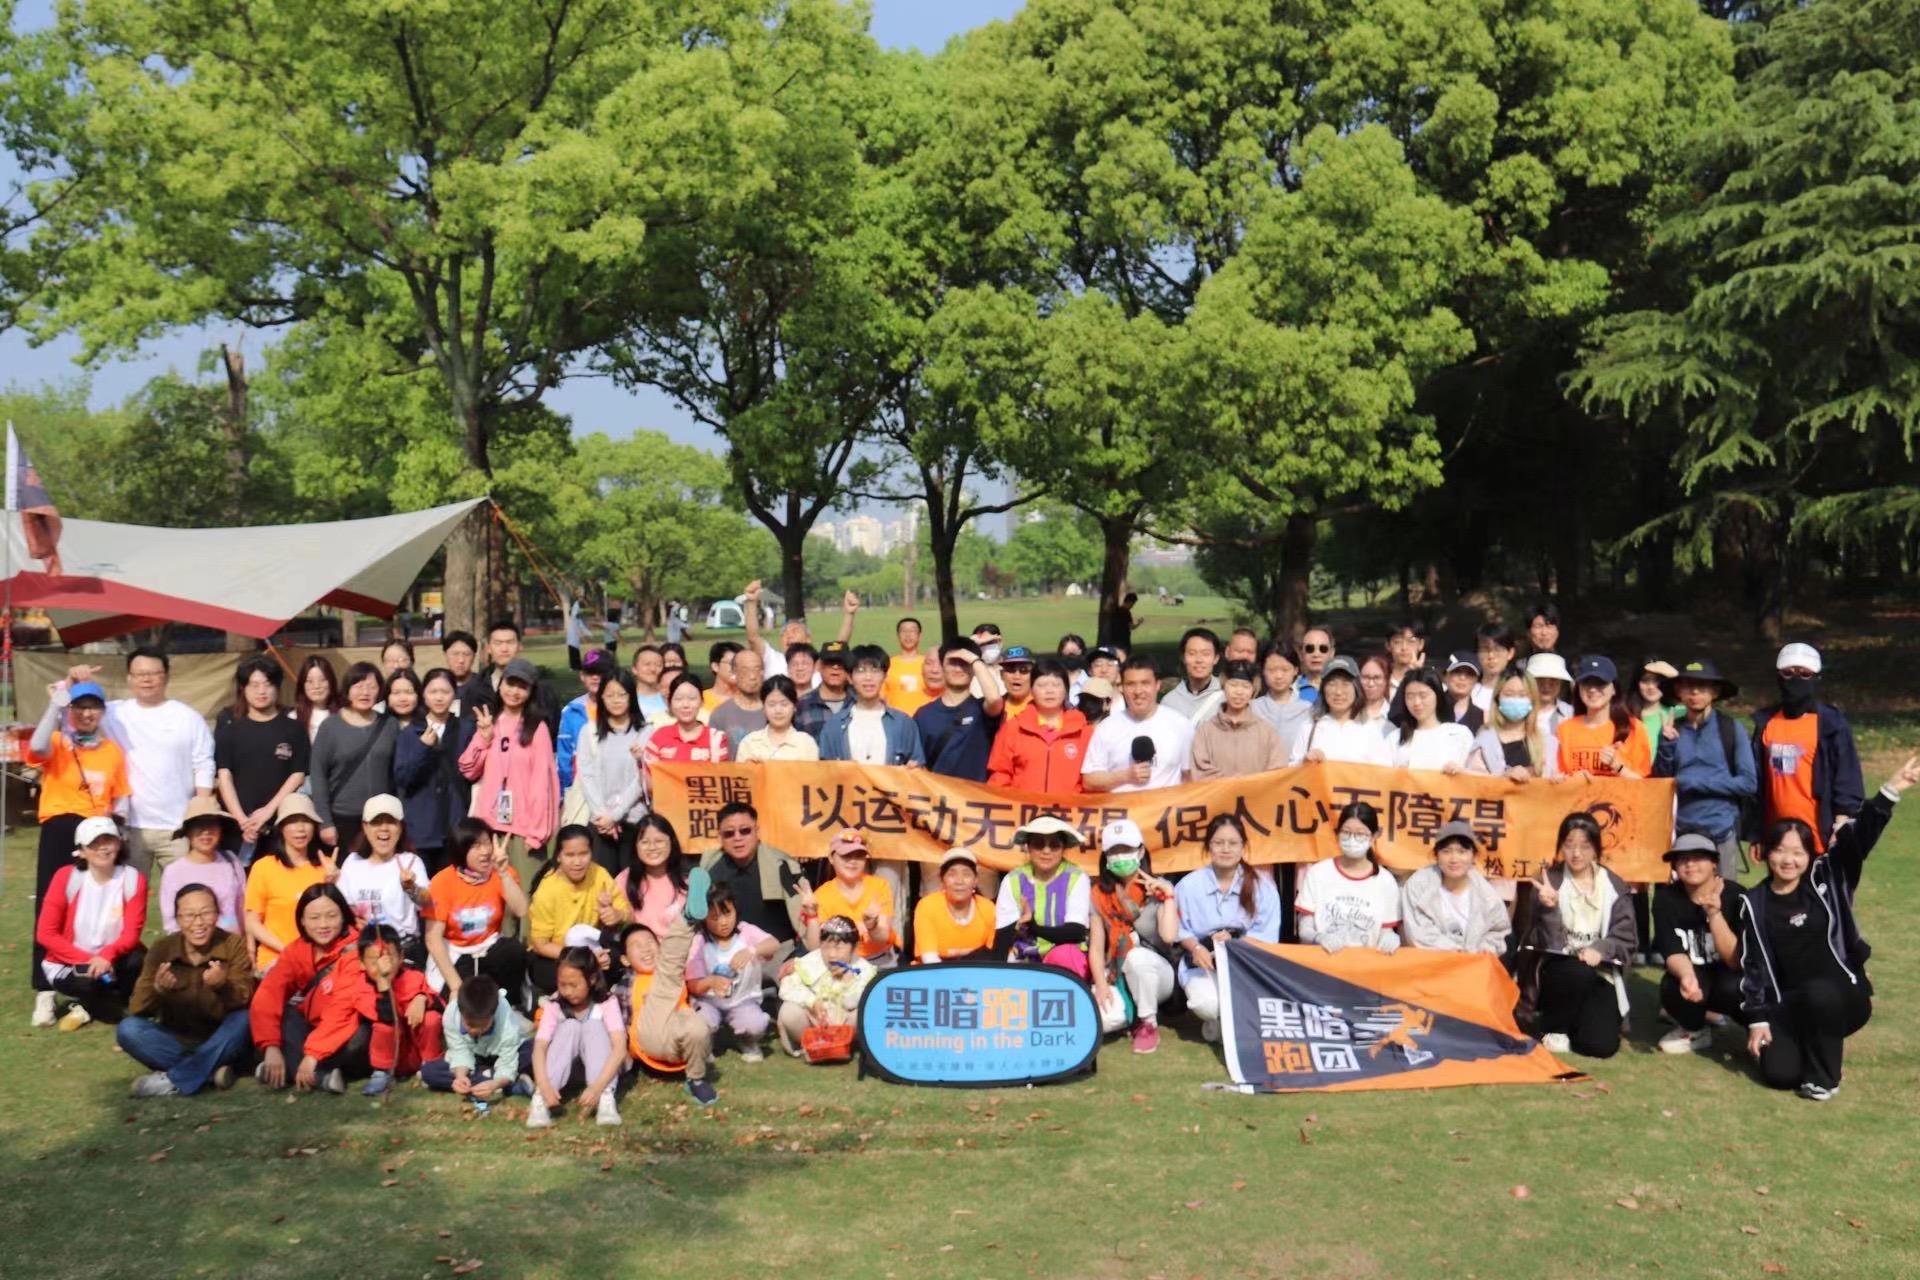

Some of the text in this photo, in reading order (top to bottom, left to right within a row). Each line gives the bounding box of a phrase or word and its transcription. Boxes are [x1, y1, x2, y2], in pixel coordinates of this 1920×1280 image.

[686, 776, 753, 805] 黑暗
[885, 987, 1076, 1030] 黑暗跑团
[1258, 997, 1351, 1041] 黑暗
[885, 1030, 1076, 1054] Running in the Dark
[1263, 1041, 1361, 1075] 跑团
